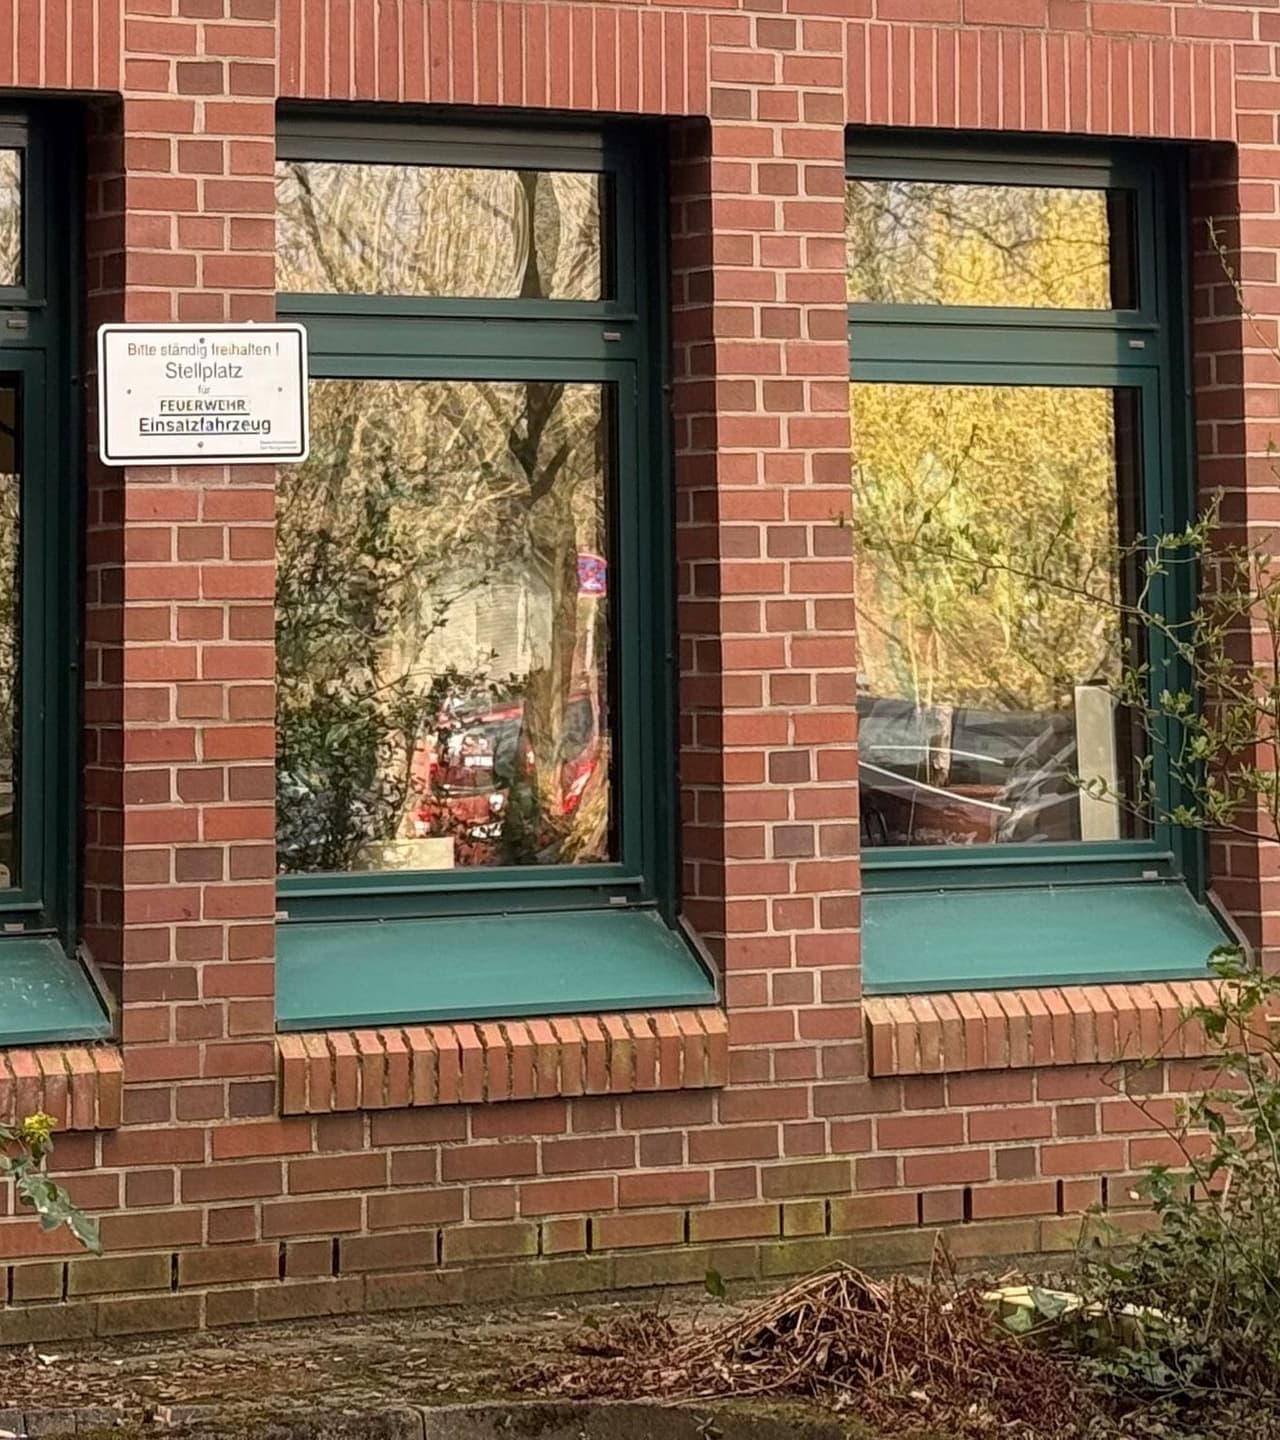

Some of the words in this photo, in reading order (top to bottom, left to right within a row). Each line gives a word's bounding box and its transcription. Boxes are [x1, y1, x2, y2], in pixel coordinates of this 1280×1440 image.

[127, 342, 157, 357] Bitte
[160, 342, 208, 359] ständig
[211, 342, 271, 357] freihalten
[275, 342, 280, 357] !
[165, 361, 244, 382] Stellplatz
[198, 384, 211, 395] für
[160, 399, 246, 412] FEUERWEHR
[139, 417, 272, 435] Einsatzfahrzeug
